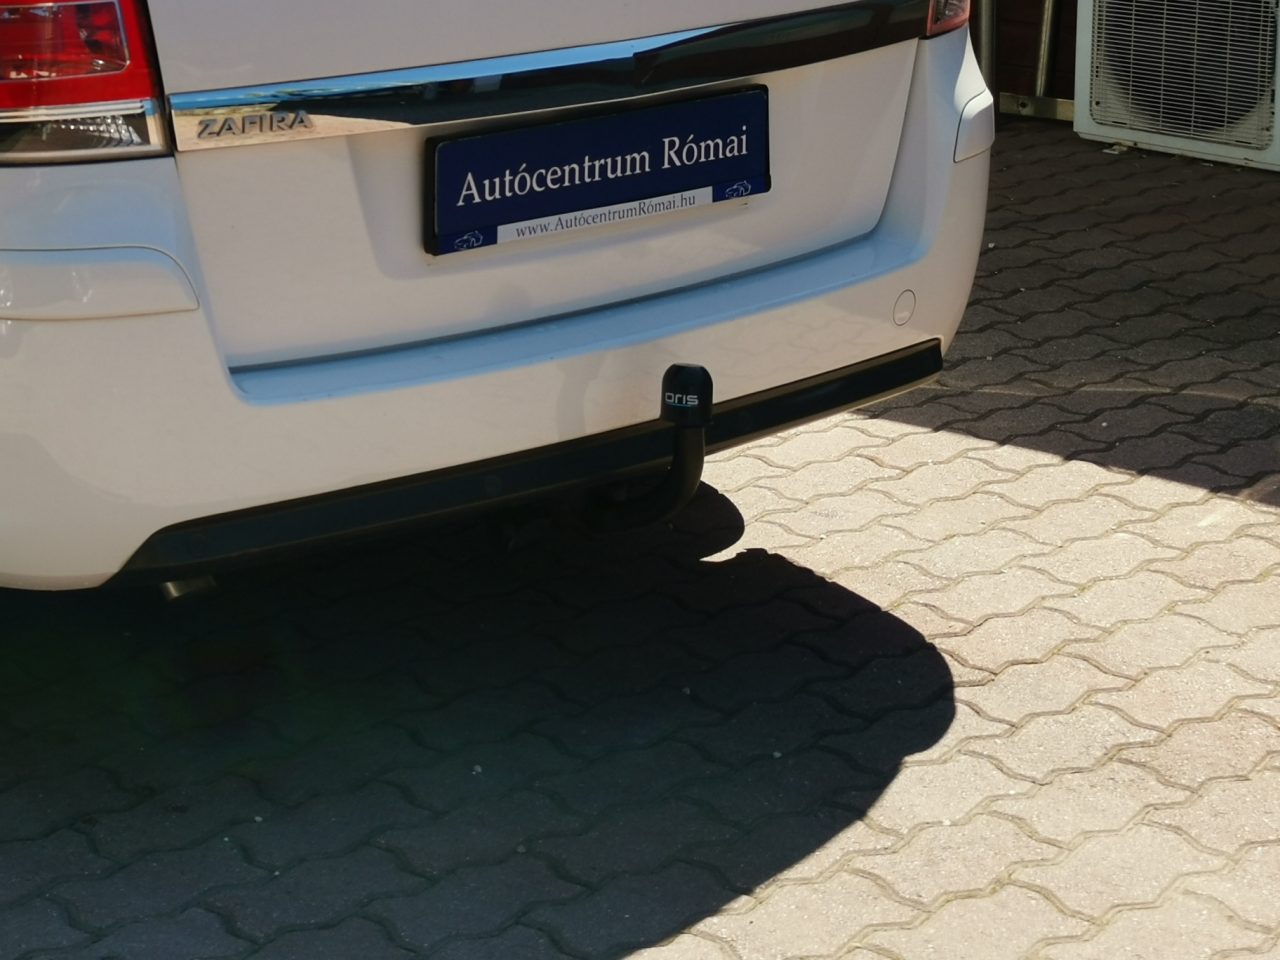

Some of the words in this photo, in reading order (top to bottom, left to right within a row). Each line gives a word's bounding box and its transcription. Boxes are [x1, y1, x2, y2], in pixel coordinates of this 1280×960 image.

[198, 109, 315, 139] ZAFIRA
[456, 149, 651, 207] Autócentrum
[661, 124, 748, 169] Római
[515, 193, 696, 240] www.AutócentrumRómai.hu
